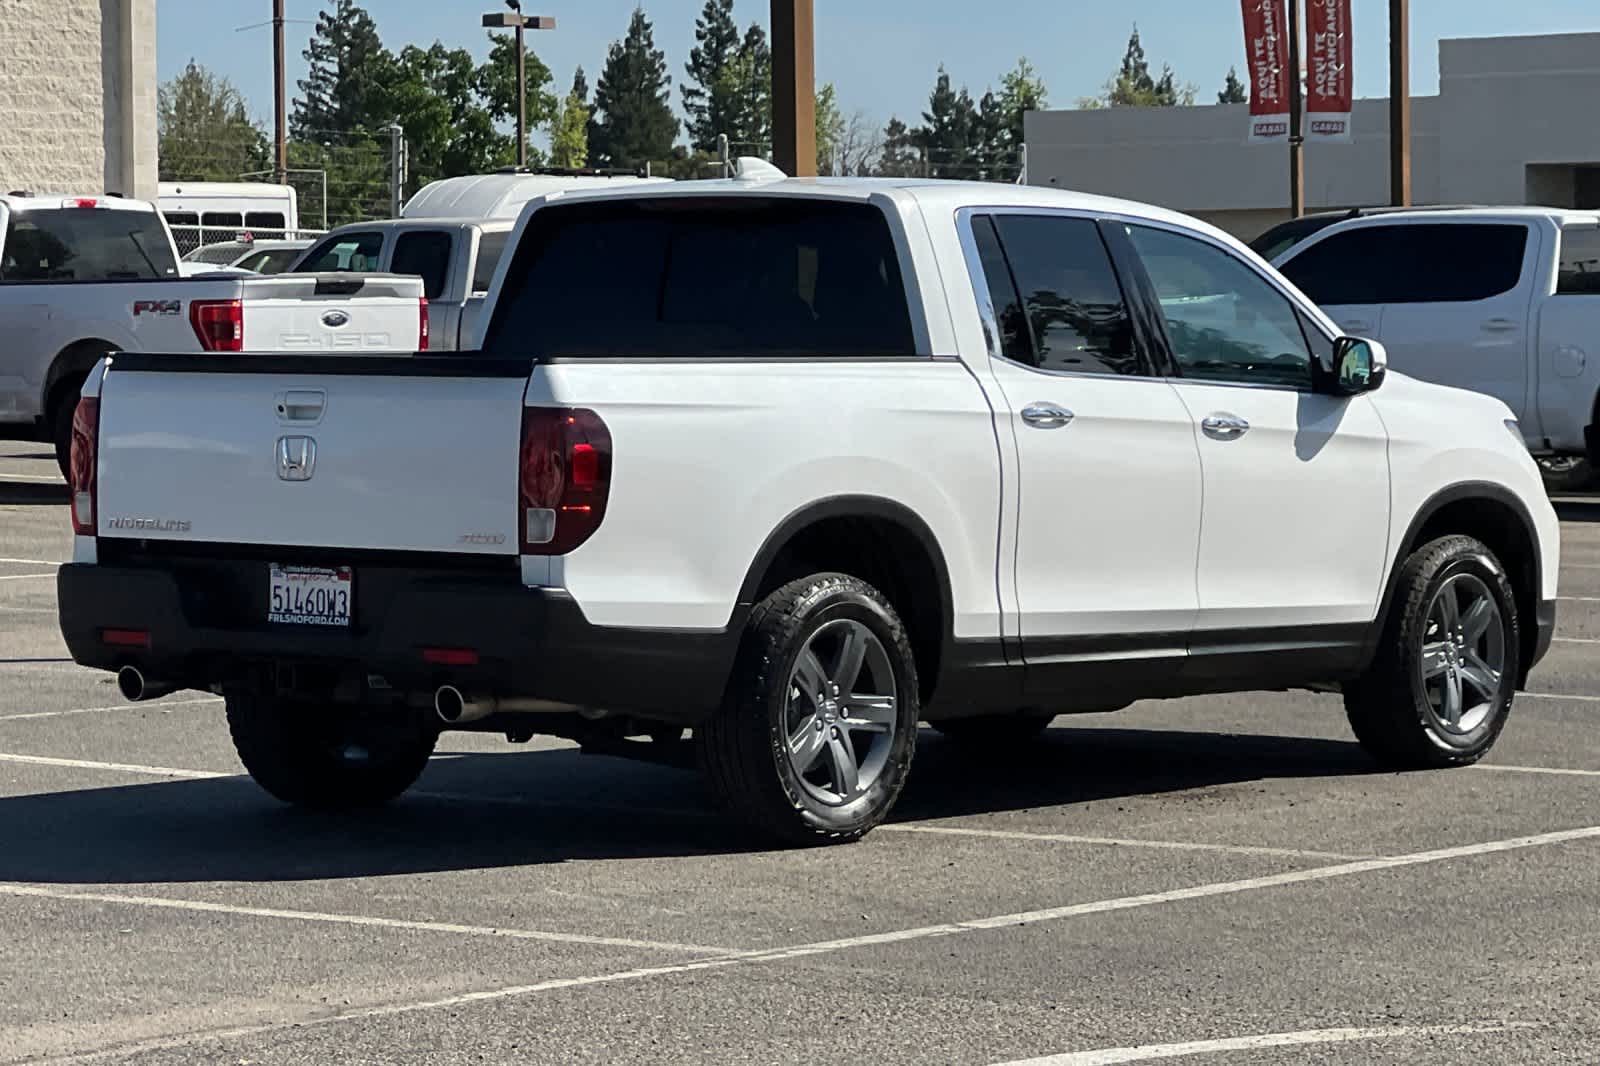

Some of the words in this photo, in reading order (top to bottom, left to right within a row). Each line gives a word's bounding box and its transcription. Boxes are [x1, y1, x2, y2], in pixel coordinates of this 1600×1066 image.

[1253, 37, 1265, 57] TE
[1315, 32, 1325, 52] TE
[133, 300, 181, 315] FX4
[273, 585, 347, 616] 51460W3
[267, 613, 348, 625] FRESNOFORD.COM
